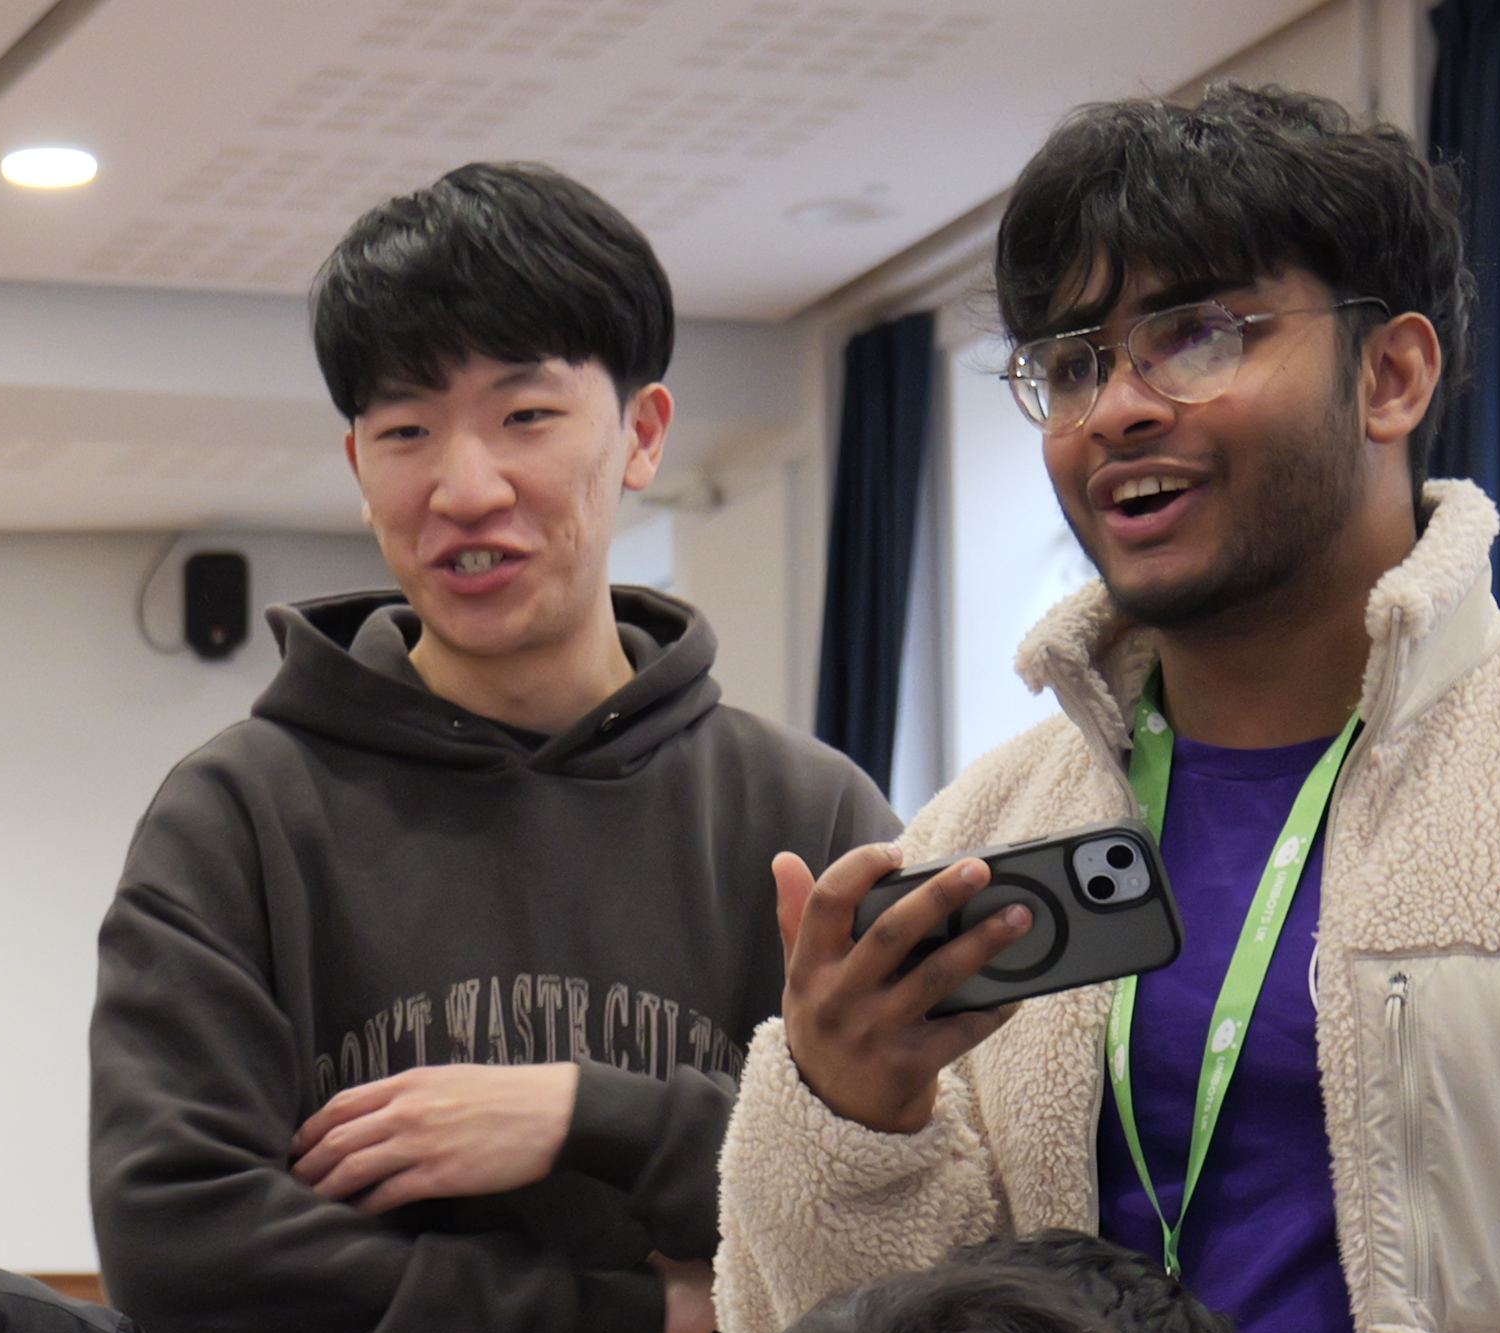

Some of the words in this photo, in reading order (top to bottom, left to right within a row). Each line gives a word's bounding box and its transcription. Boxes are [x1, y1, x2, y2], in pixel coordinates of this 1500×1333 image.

[1258, 869, 1289, 923] UNIBOTS
[1253, 923, 1268, 943] UK
[444, 973, 591, 1065] WASTE
[1203, 1055, 1226, 1114] UNIBOTS
